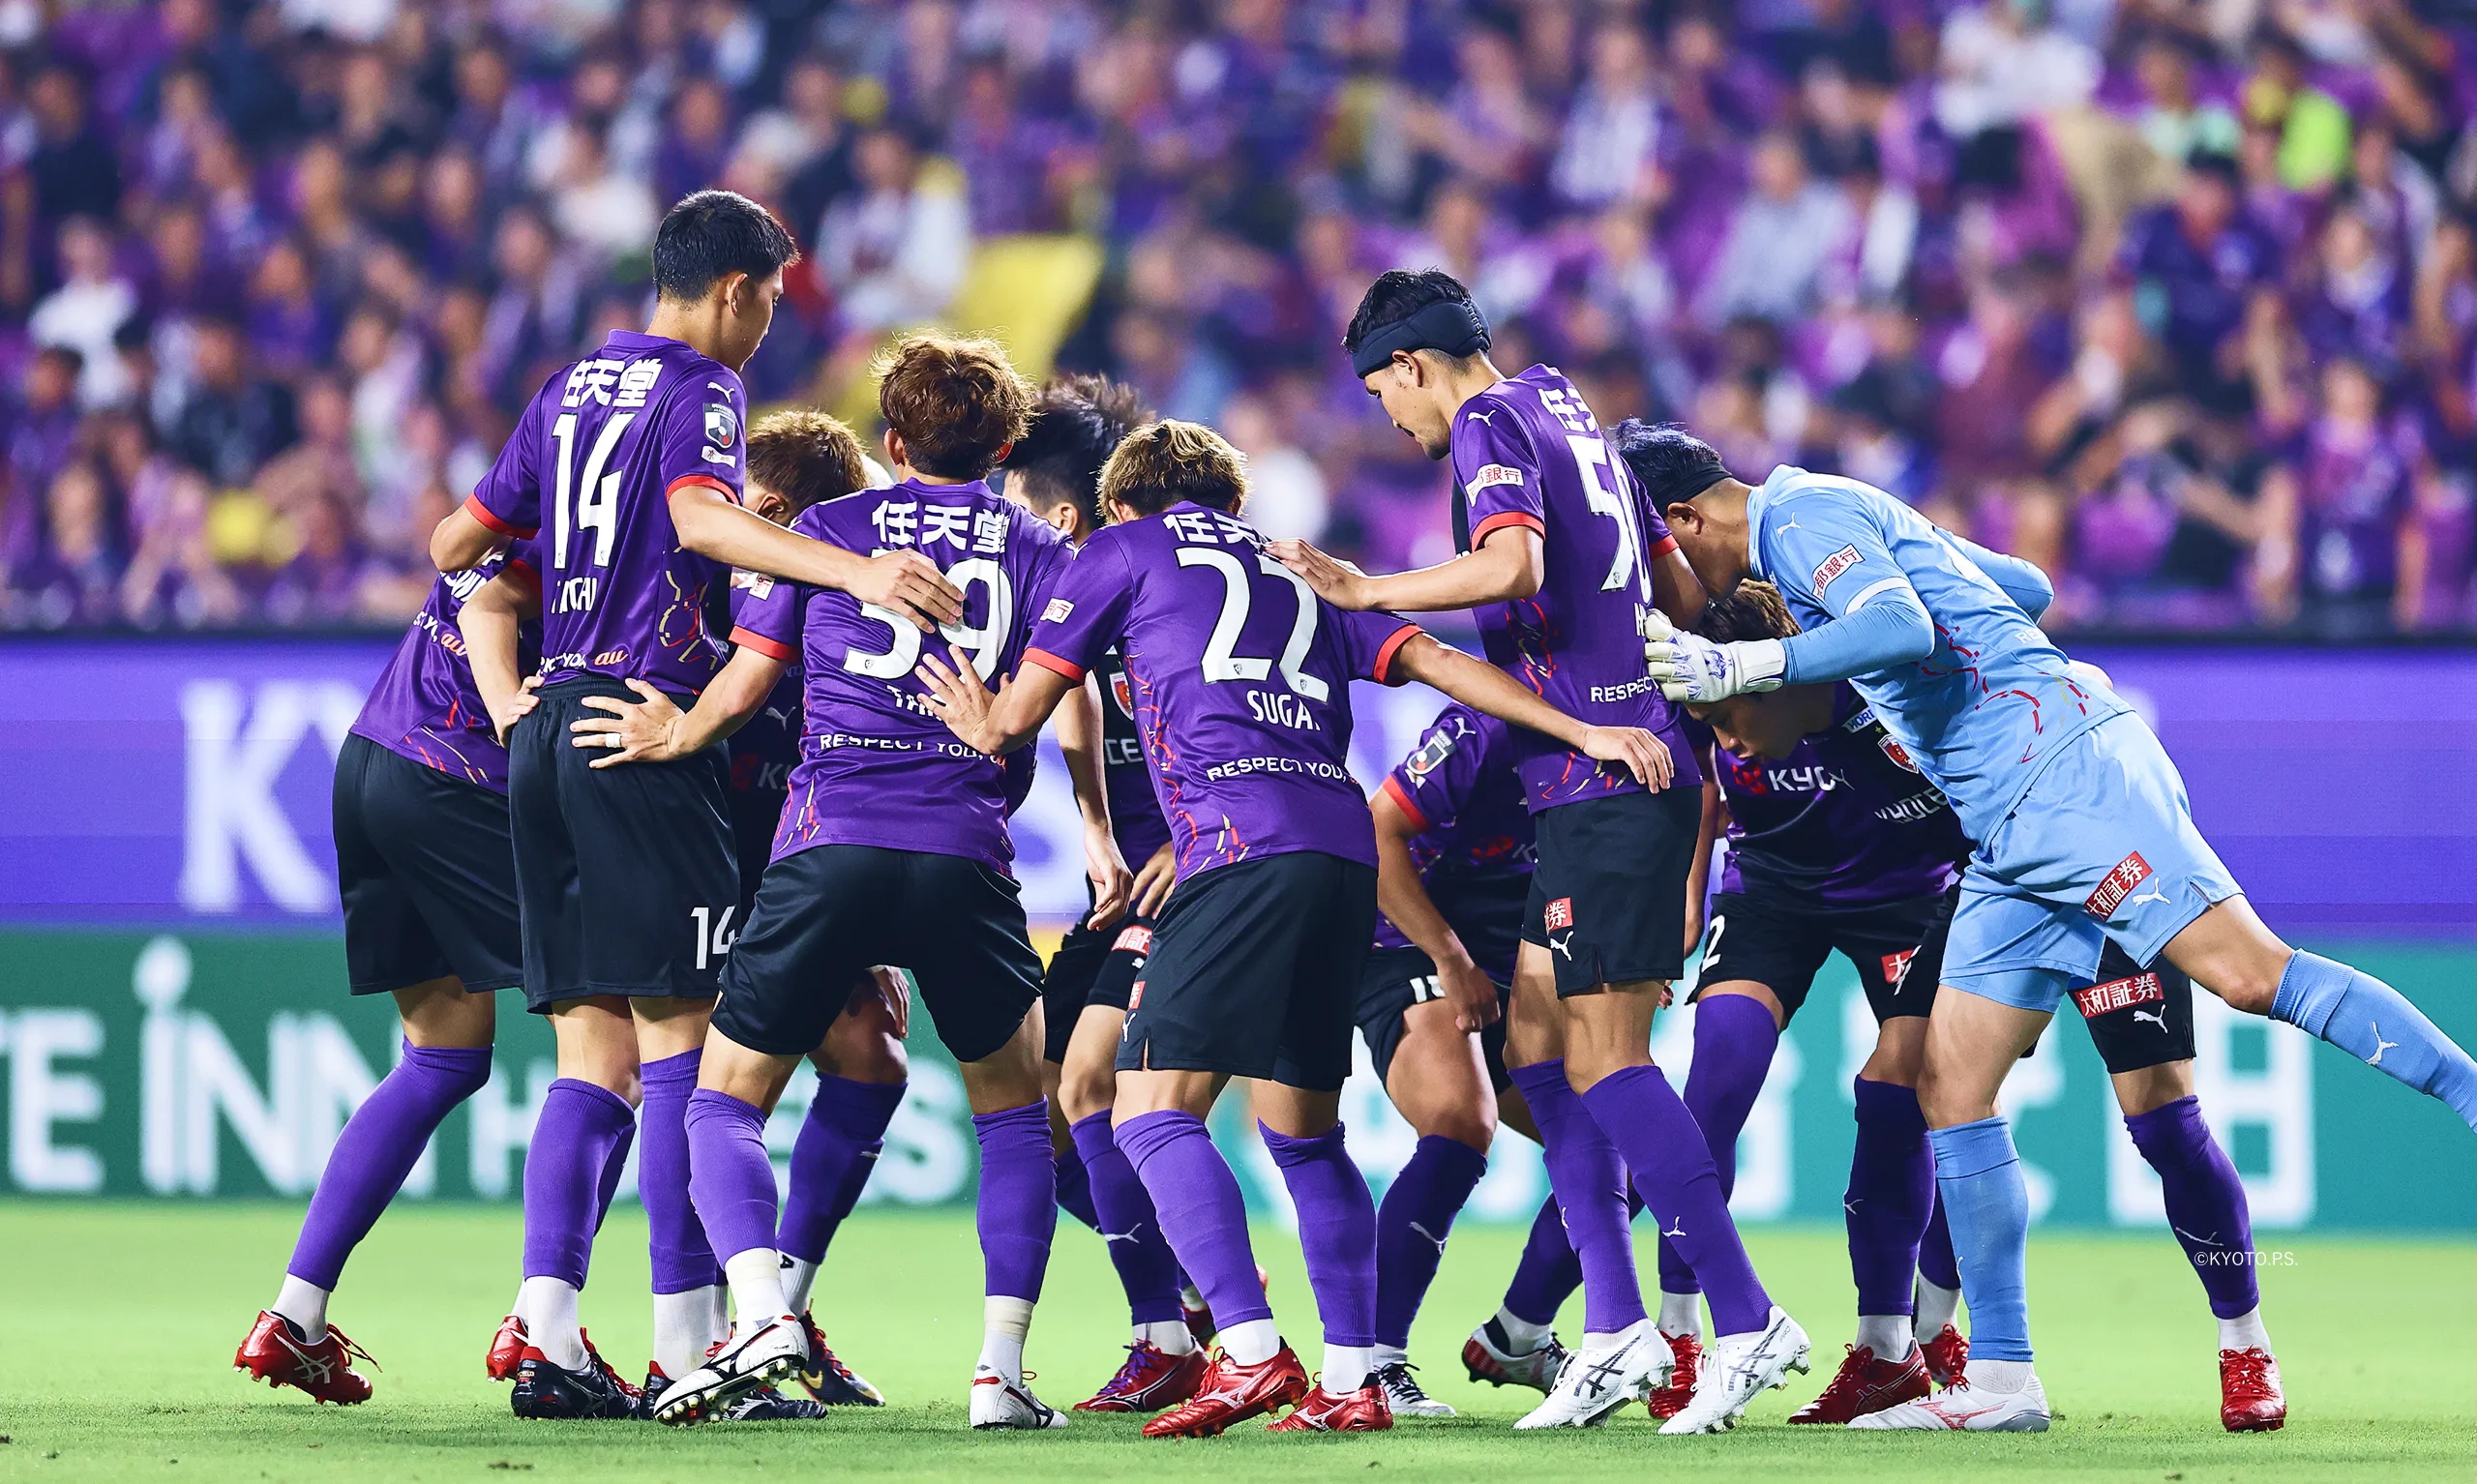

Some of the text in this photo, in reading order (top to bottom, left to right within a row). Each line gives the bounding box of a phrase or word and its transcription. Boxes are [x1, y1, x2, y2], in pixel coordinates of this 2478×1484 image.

[561, 359, 663, 407] 任天堂
[552, 411, 636, 570] 14
[872, 500, 1009, 553] 任天堂
[1163, 512, 1264, 553] 任天
[1175, 547, 1329, 703] 22
[593, 650, 628, 666] au
[1305, 762, 1347, 784] YOU,
[2086, 858, 2143, 920] 大和証券
[691, 905, 736, 969] 14
[1545, 902, 1567, 931] 券
[2079, 976, 2158, 1017] 大和証券
